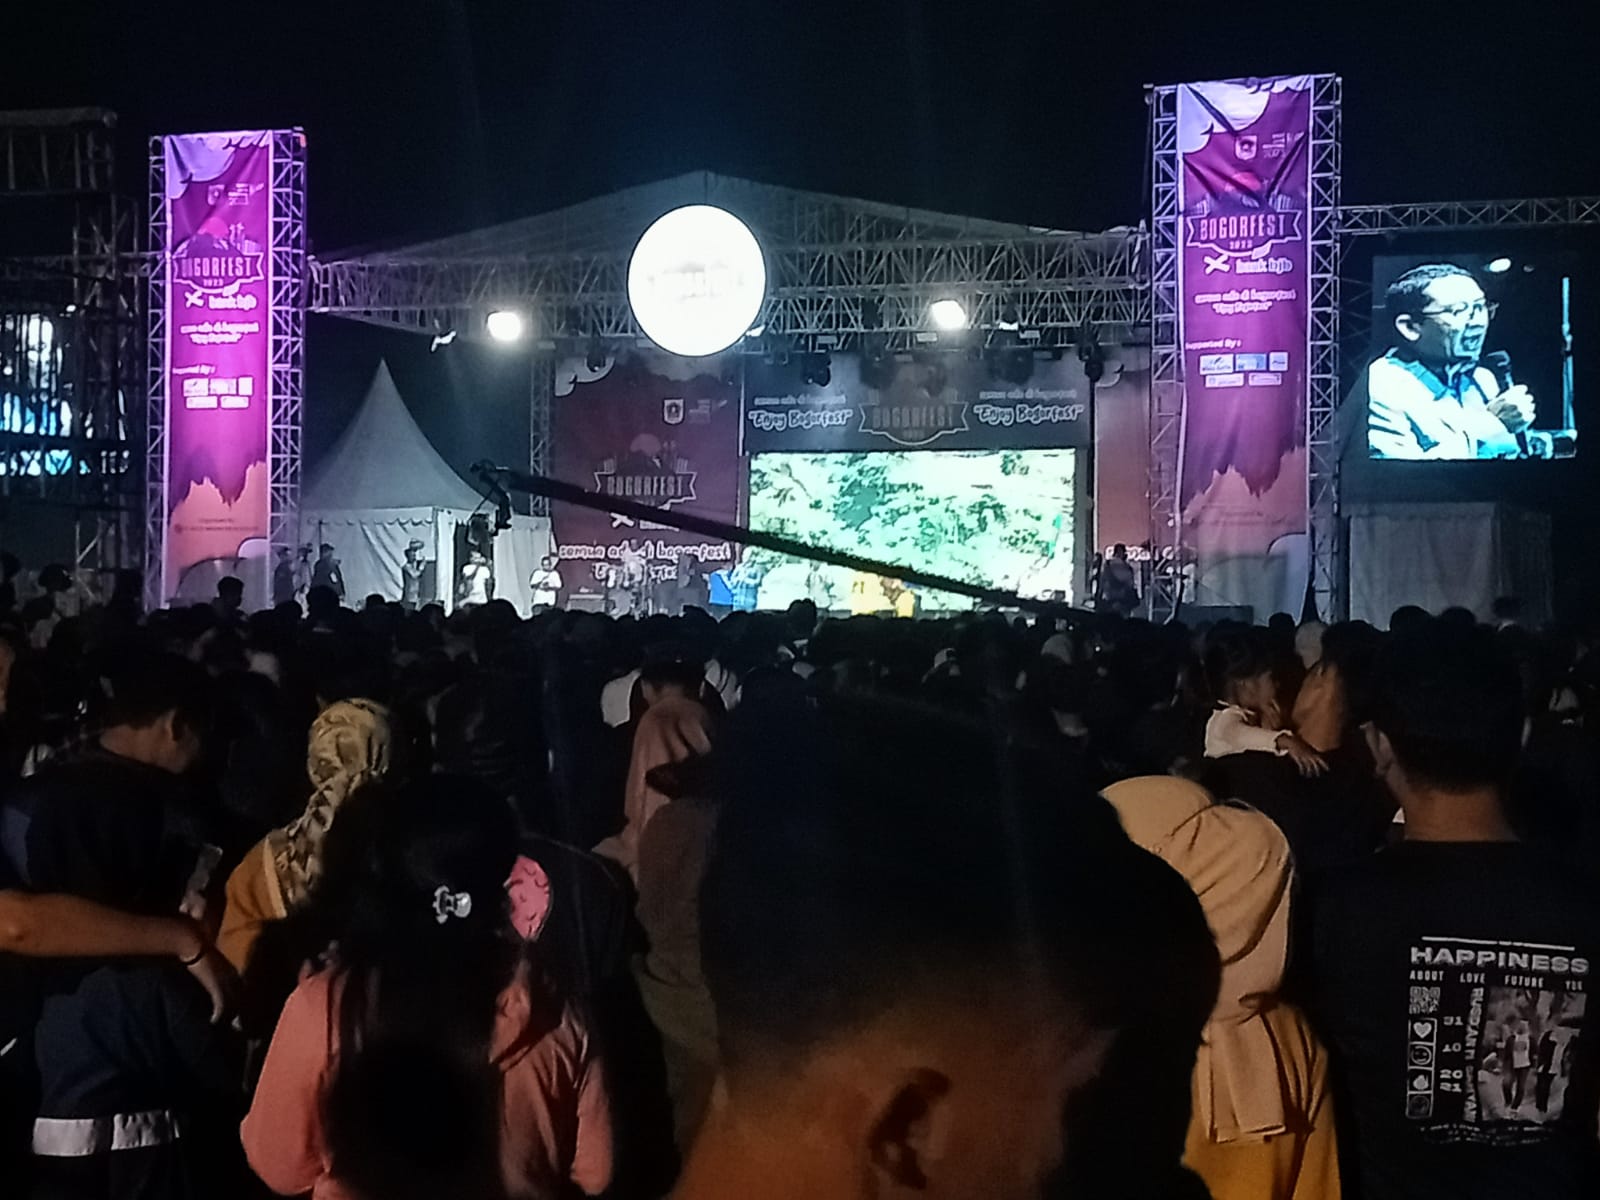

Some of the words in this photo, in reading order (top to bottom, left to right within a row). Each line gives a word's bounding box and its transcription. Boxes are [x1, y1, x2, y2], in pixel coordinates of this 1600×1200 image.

[1199, 214, 1286, 241] BOGORFEST
[1410, 946, 1590, 974] HAPPINESS
[1409, 970, 1445, 982] ABOUT
[1460, 972, 1486, 984] LOVE
[1504, 974, 1545, 989] FUTURE
[1442, 1042, 1462, 1053] 10
[1439, 1068, 1463, 1079] 20
